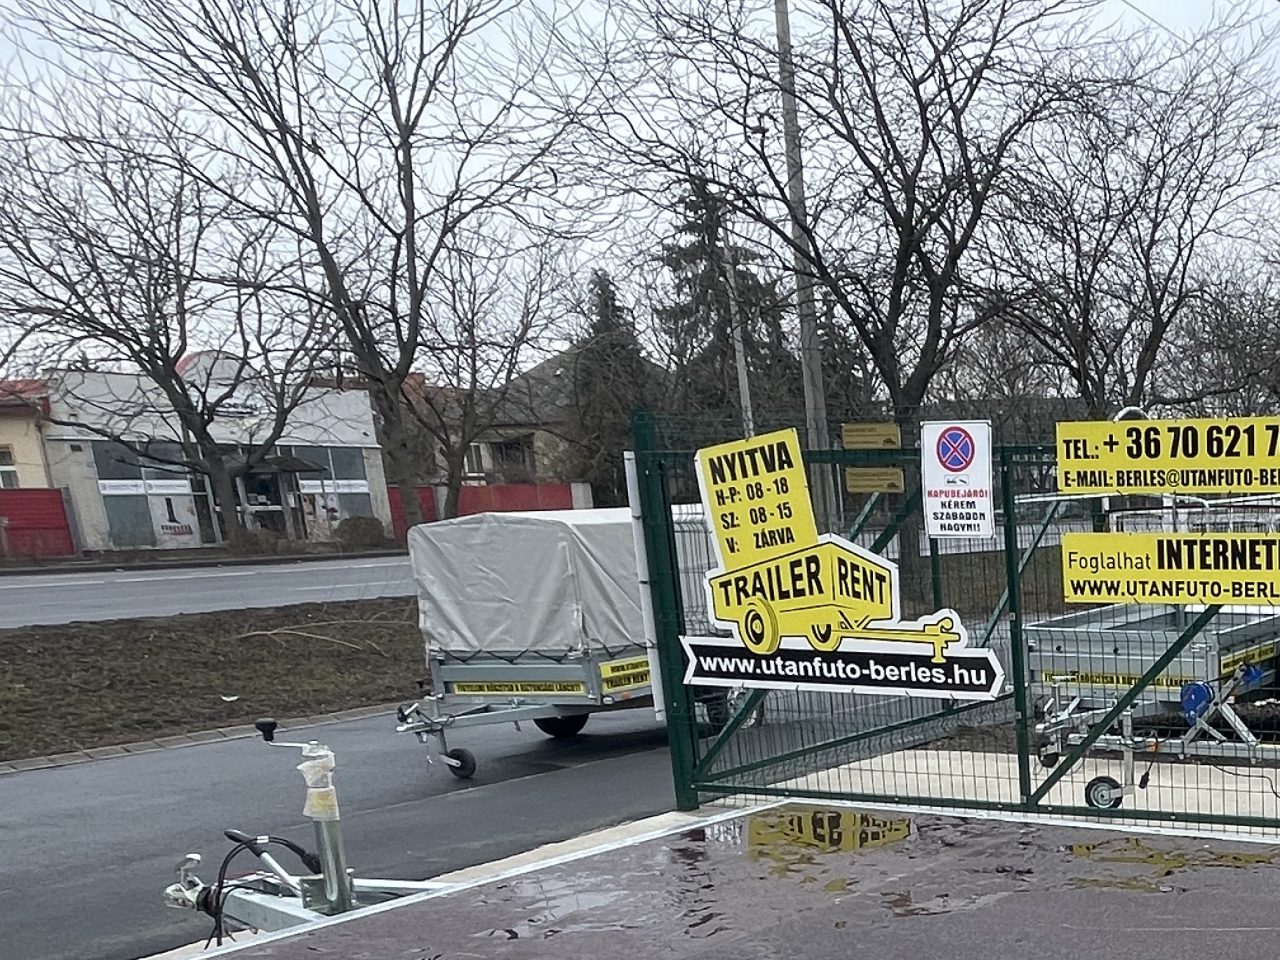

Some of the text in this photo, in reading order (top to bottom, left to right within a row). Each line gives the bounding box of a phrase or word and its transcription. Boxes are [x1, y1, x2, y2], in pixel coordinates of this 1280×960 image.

[1063, 438, 1099, 460] TEL.:
[1167, 425, 1199, 459] 70
[1206, 424, 1256, 458] 621
[708, 441, 794, 485] NYITVA
[1064, 469, 1113, 488] E-MAIL:
[715, 486, 742, 506] H-P:
[940, 500, 976, 510] KÉREM
[720, 512, 740, 530] SZ:
[933, 511, 986, 521] SZABADON
[725, 526, 795, 554] V: ZÁRVA
[1068, 551, 1151, 574] Foglalhat
[718, 554, 887, 607] TRAILER RENT
[699, 654, 987, 686] www.utanfuto-berles.hu
